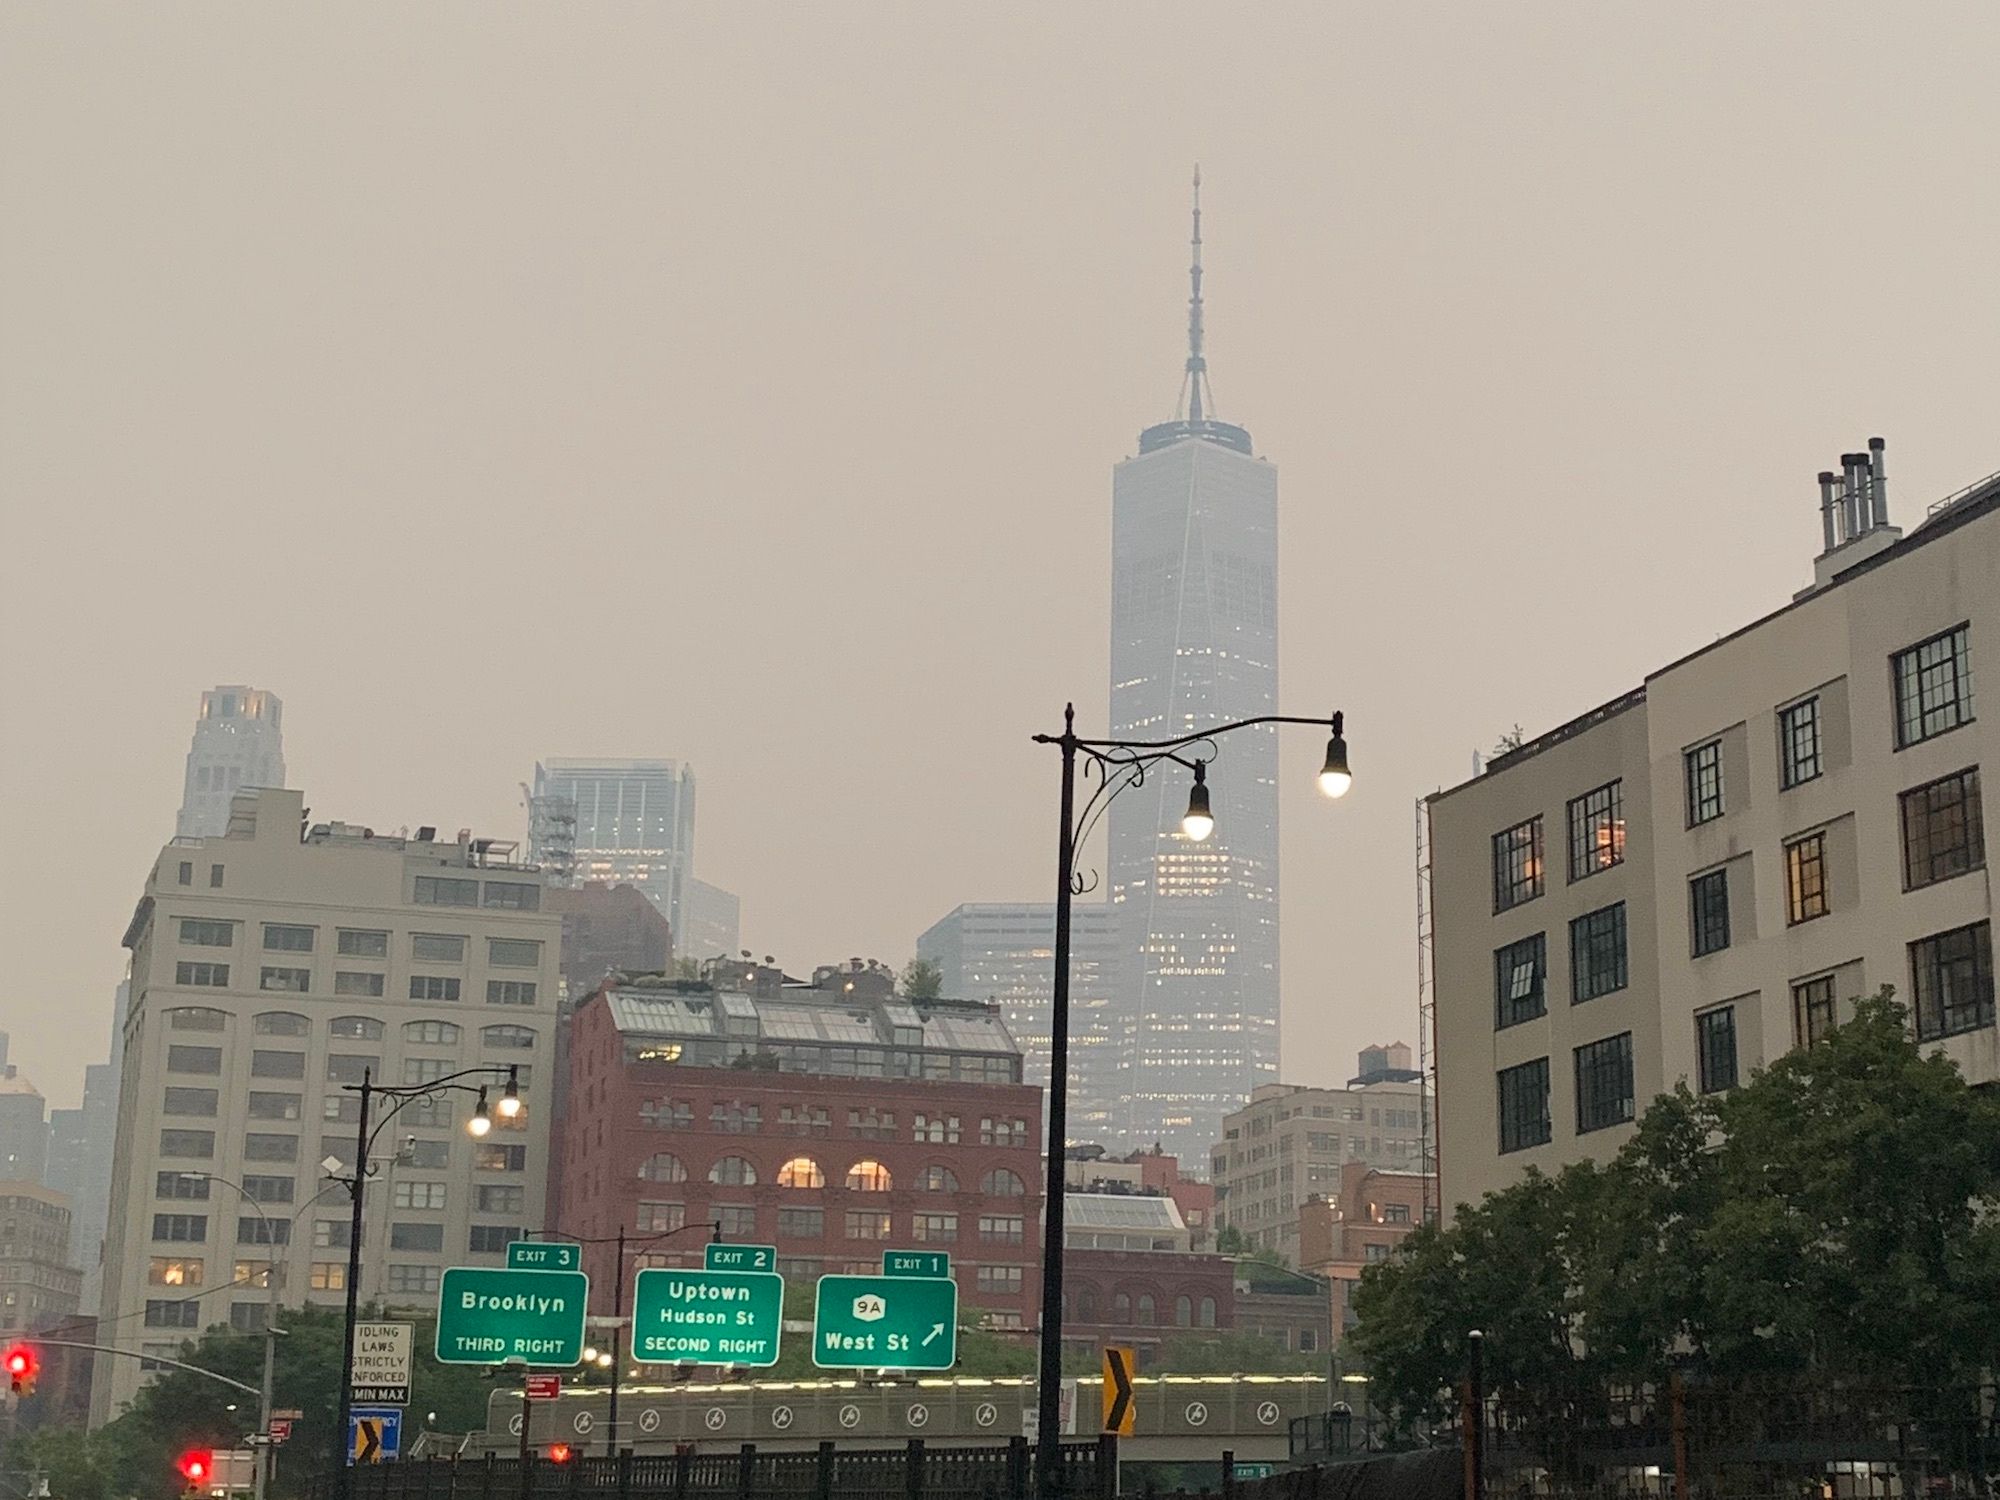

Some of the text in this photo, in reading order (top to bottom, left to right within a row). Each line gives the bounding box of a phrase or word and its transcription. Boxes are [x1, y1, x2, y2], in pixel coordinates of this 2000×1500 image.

[516, 1249, 570, 1265] EXIT 3
[714, 1251, 766, 1267] EXIT 2
[894, 1257, 938, 1272] EXIT 1
[669, 1281, 750, 1303] Uptown
[461, 1291, 565, 1316] Brooklyn
[857, 1301, 881, 1313] 9A
[660, 1308, 754, 1325] Hudson St
[359, 1326, 399, 1338] IDLING
[361, 1341, 395, 1353] LAWS
[455, 1336, 565, 1354] THIRD RIGHT
[645, 1336, 767, 1354] SECOND RIGHT
[825, 1332, 909, 1351] West St
[354, 1371, 406, 1383] NFORCED
[354, 1388, 405, 1400] MIN MAX
